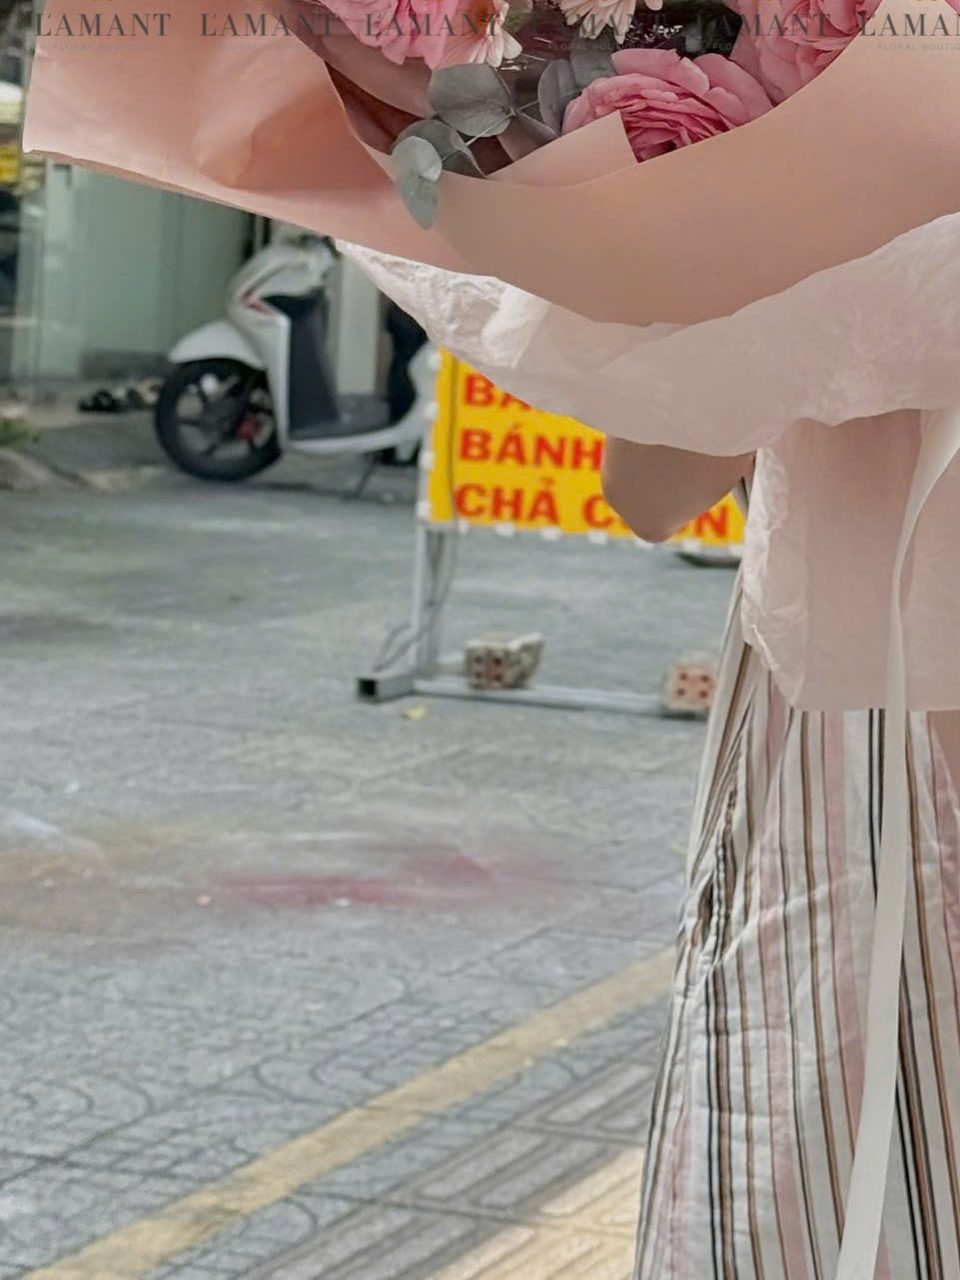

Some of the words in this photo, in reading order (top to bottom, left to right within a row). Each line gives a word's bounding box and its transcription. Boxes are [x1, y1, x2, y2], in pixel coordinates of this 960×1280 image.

[459, 424, 605, 470] BÁNH
[454, 476, 560, 526] CHẢ
[583, 494, 729, 538] CN
